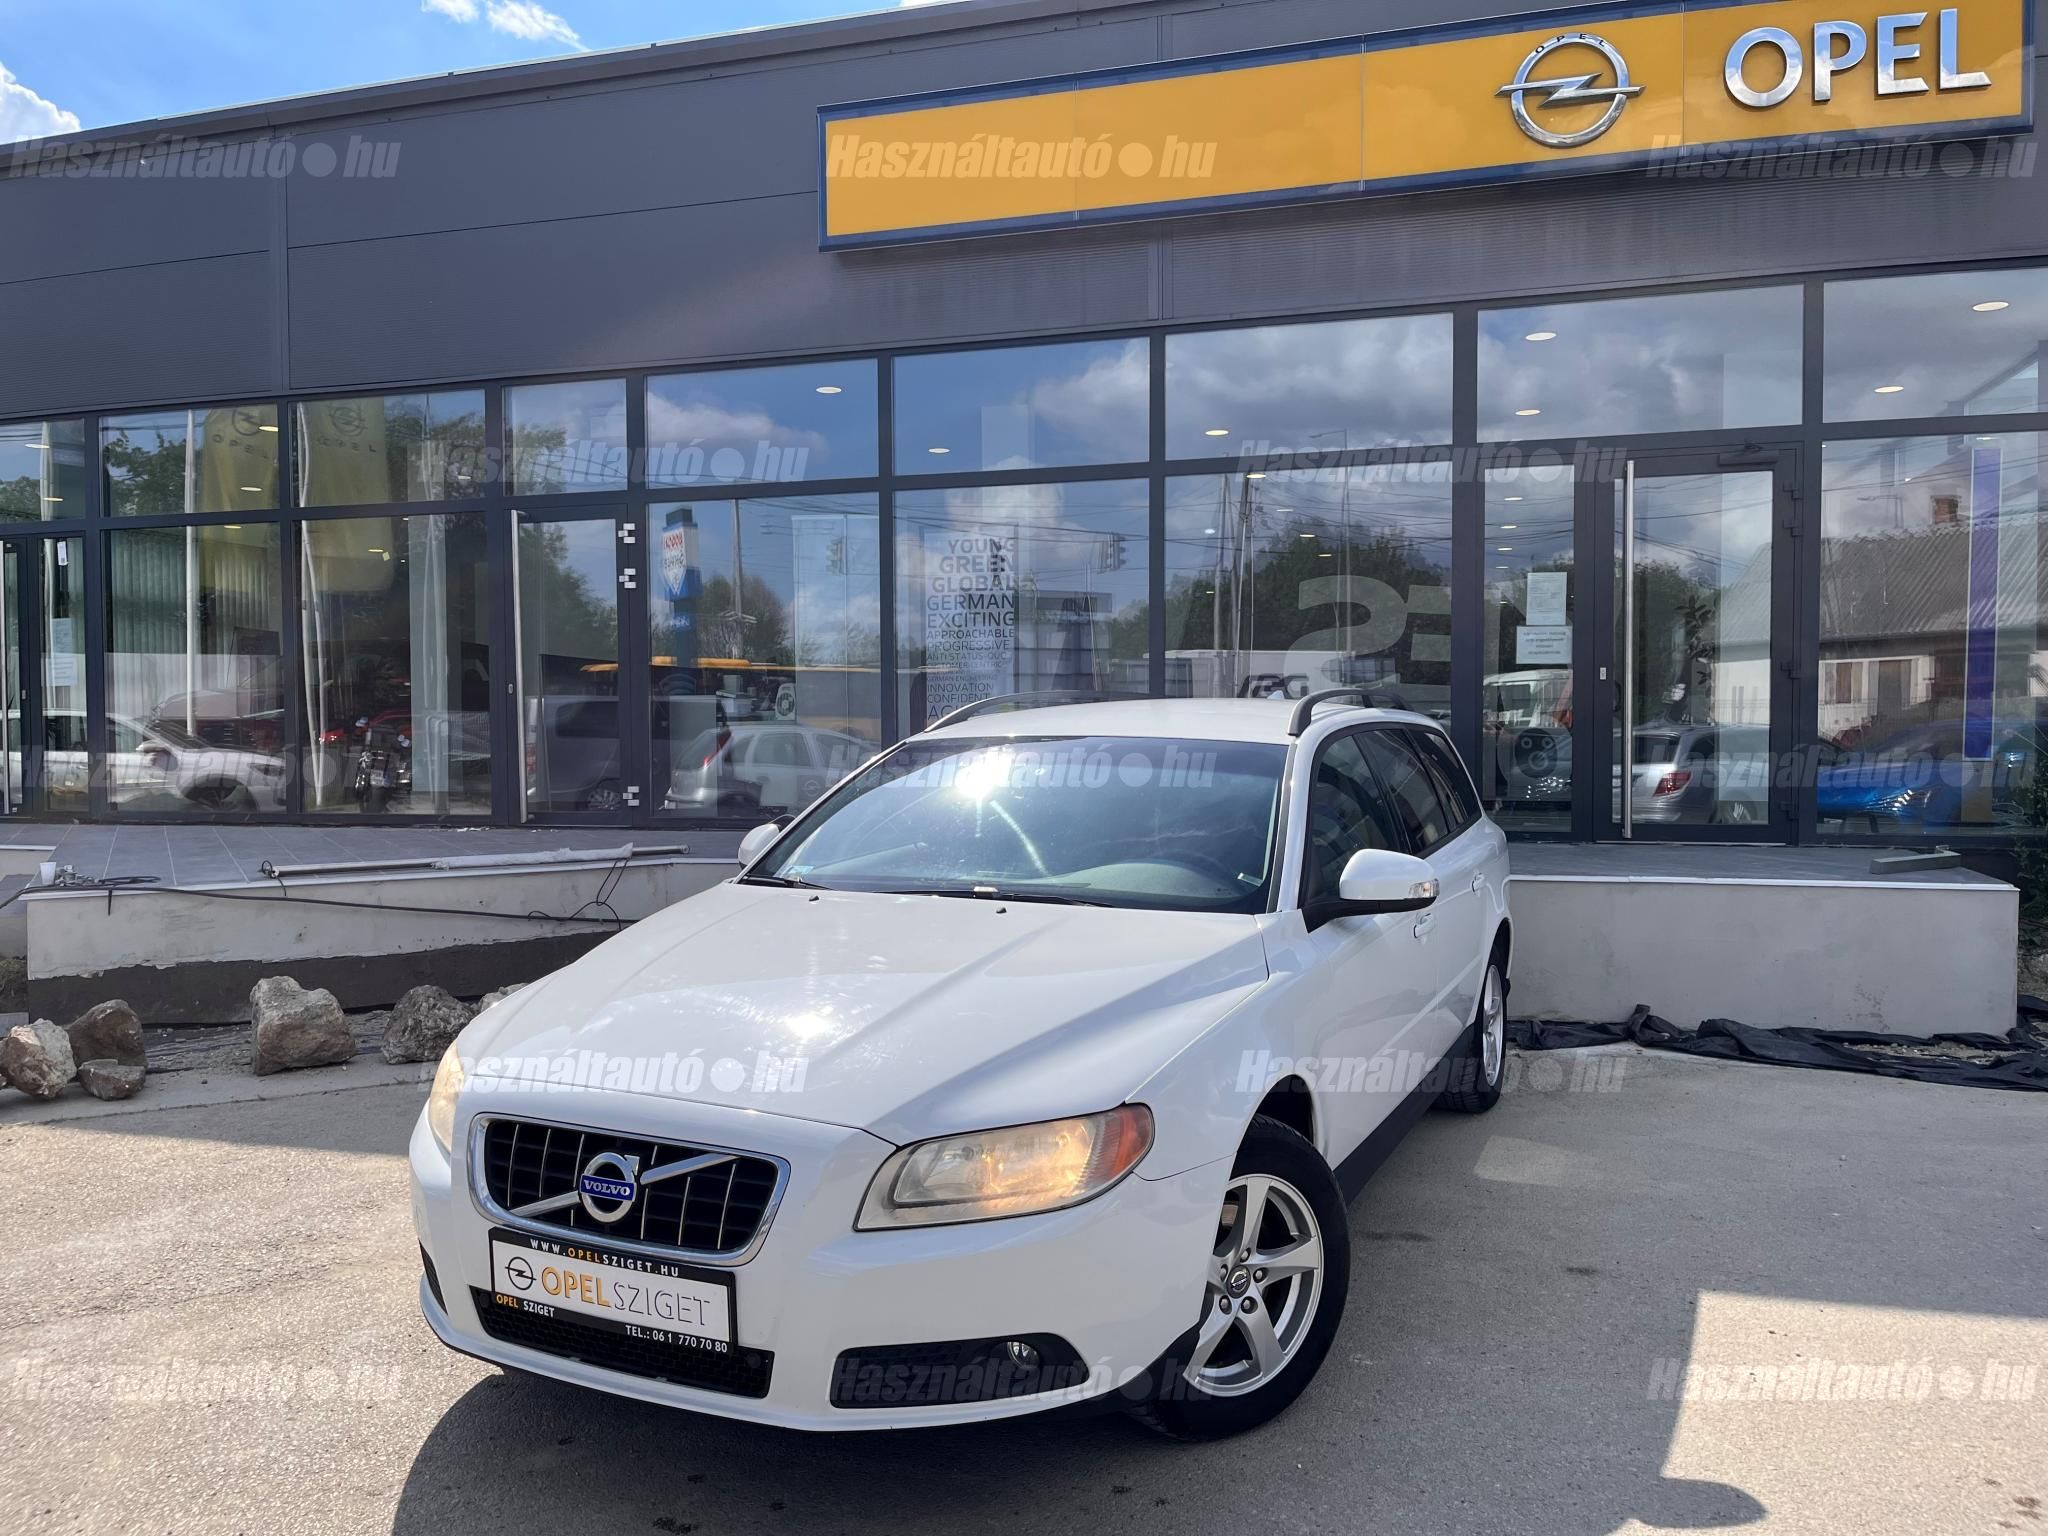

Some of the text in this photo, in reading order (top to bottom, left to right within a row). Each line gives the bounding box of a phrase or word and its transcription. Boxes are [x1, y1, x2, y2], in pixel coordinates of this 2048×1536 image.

[1535, 33, 1606, 53] OPEL
[1724, 8, 1992, 108] OPEL
[948, 538, 1015, 555] YOUNG
[939, 554, 1015, 574] GREEN
[932, 575, 1015, 594] GLOBAL
[927, 593, 1015, 611] GERMAN
[927, 610, 1015, 628] EXCITING
[927, 628, 1015, 641] APPROACHABLE
[927, 639, 1010, 652] PROGRESSIVE
[927, 683, 994, 693] INNOVATION
[927, 693, 990, 703] CONFIDENT
[583, 1179, 631, 1197] VOLVO
[496, 1294, 555, 1318] OPEL SZIGET
[625, 1324, 651, 1340] TEL.:
[652, 1330, 665, 1343] 06
[678, 1335, 697, 1348] 770
[700, 1338, 713, 1351] 70
[715, 1341, 728, 1353] 80
